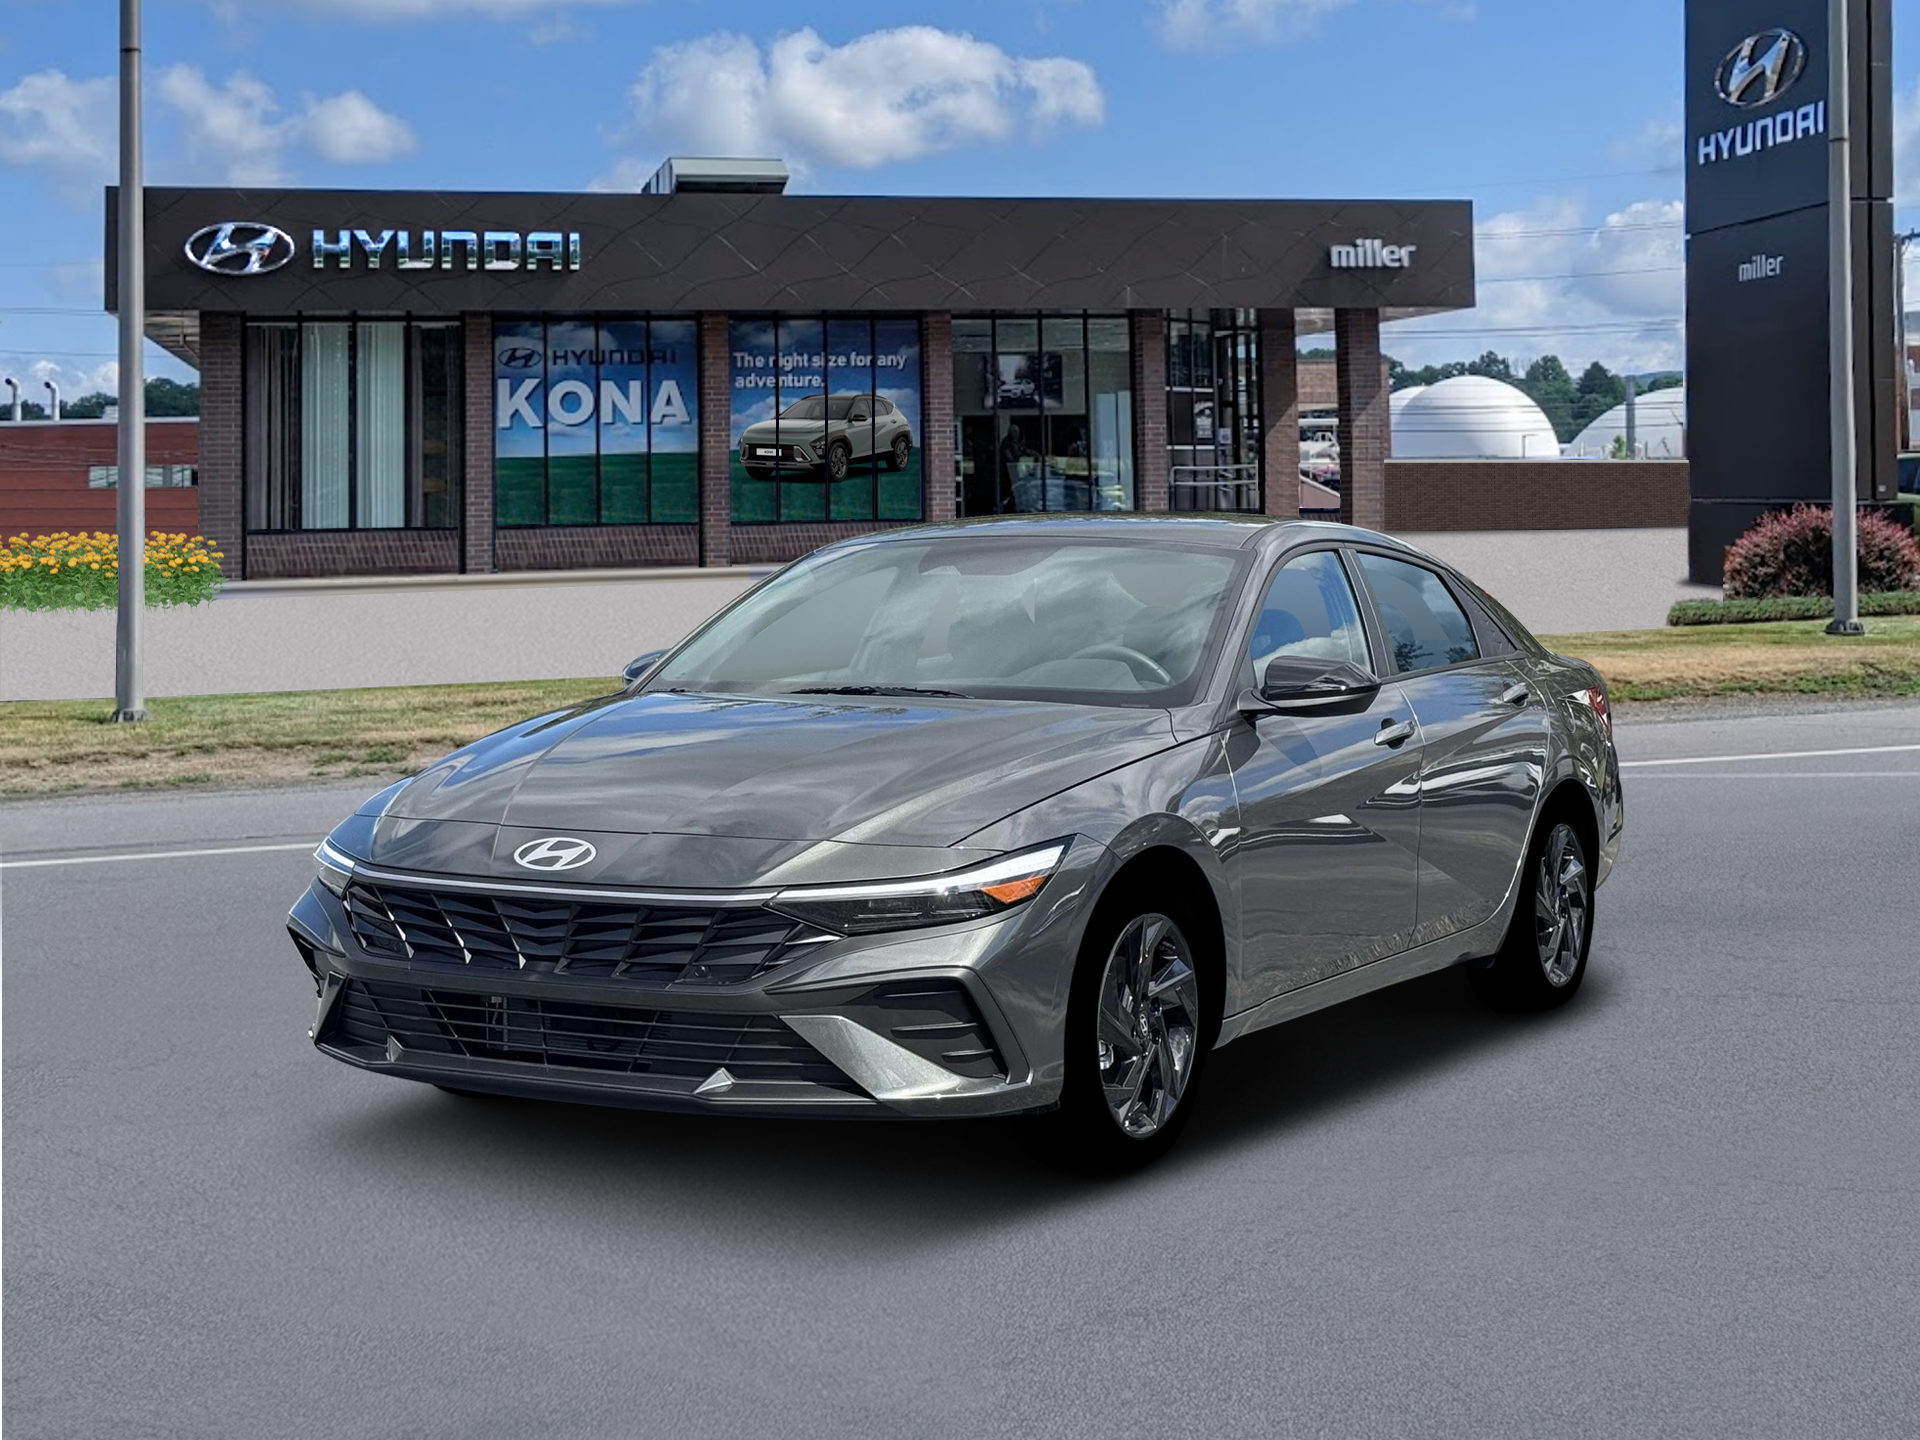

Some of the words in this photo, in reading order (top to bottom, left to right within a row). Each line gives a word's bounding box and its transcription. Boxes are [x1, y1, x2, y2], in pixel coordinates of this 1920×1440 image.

[1698, 100, 1825, 165] HYUNDAI
[312, 229, 580, 271] HYUNDAI
[1330, 238, 1417, 268] miller
[1738, 254, 1784, 282] miller
[553, 349, 676, 366] HYUNDAI
[733, 352, 765, 368] The
[768, 352, 808, 371] right
[810, 352, 847, 367] size
[850, 352, 873, 367] for
[877, 354, 907, 370] any
[735, 373, 825, 388] adventure.
[497, 377, 691, 429] KONA
